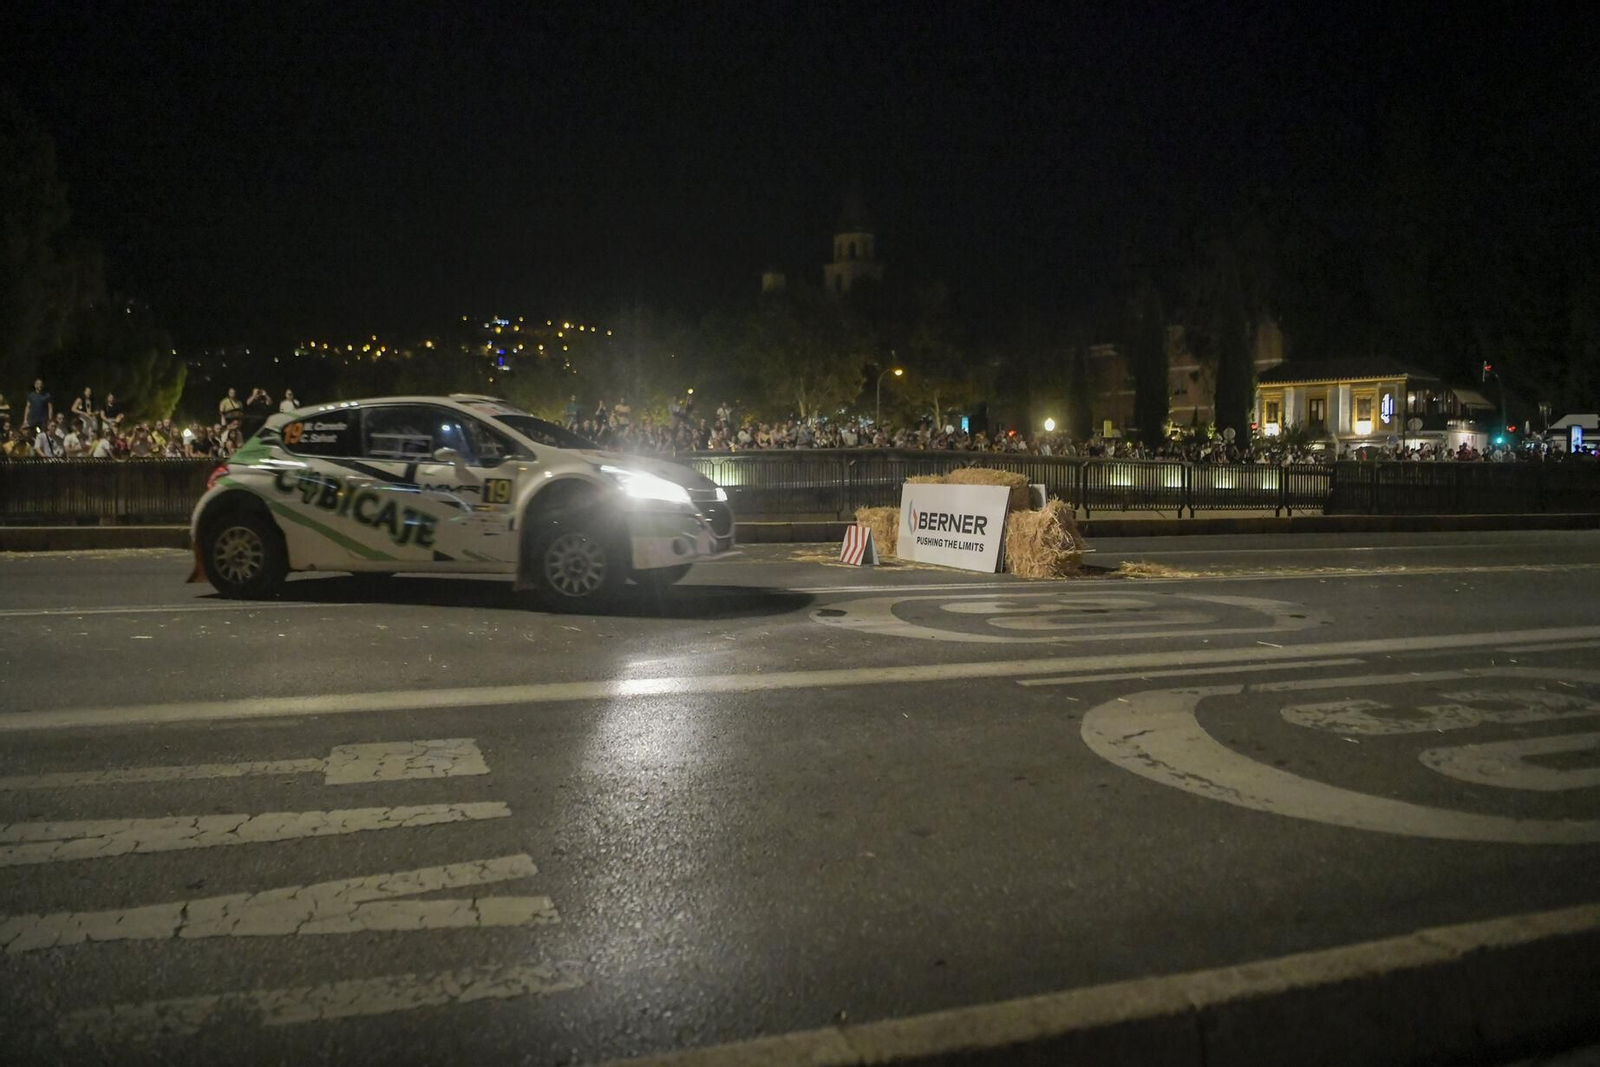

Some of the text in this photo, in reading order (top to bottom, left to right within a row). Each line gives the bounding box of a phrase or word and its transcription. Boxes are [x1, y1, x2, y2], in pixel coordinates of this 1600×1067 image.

[486, 478, 511, 503] 19
[918, 512, 987, 535] BERNER
[917, 537, 984, 552] PUSHING THE LIMITS
